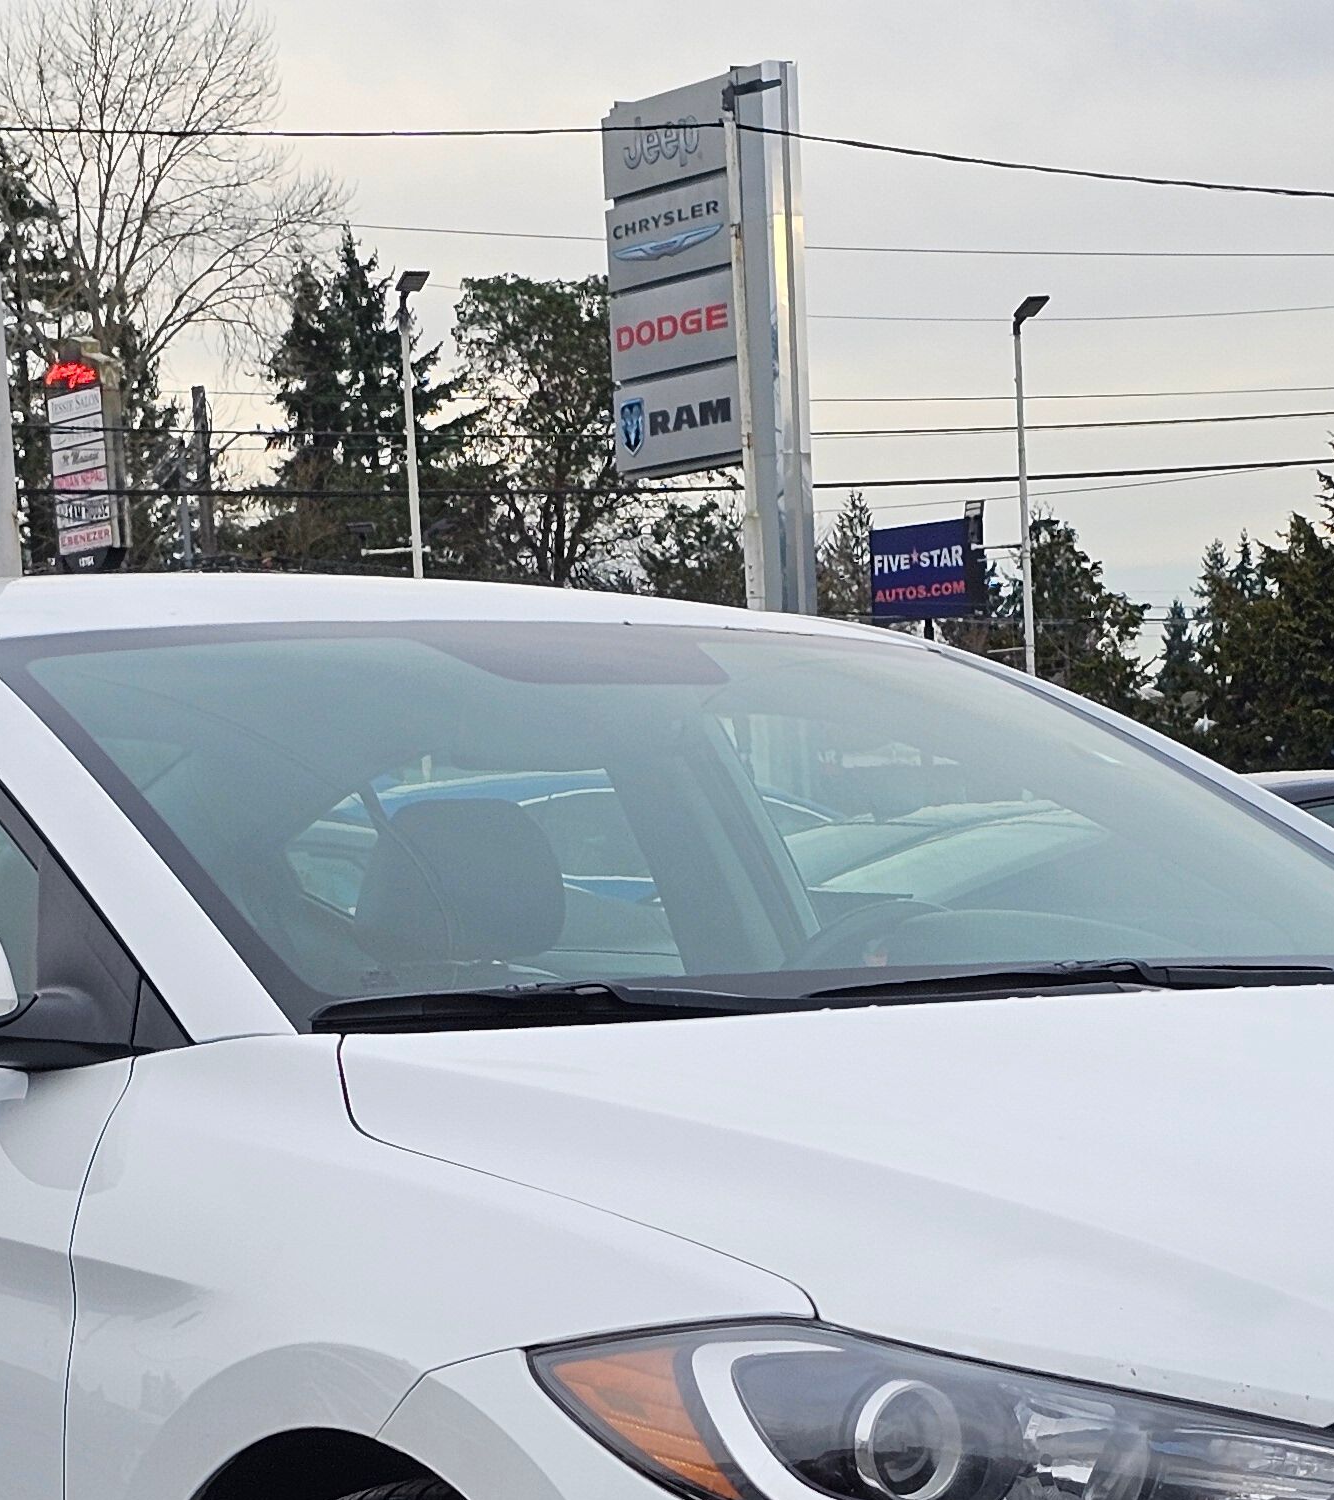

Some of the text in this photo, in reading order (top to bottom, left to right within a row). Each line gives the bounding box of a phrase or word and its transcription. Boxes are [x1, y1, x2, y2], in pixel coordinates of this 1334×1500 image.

[623, 114, 700, 170] Jeep
[612, 200, 719, 240] CHRYSLER
[616, 302, 730, 353] DODGE
[648, 396, 732, 437] RAM
[61, 528, 110, 547] EBENEZER
[874, 544, 964, 576] FIVE STAR
[875, 580, 966, 603] AUTOS.COM
